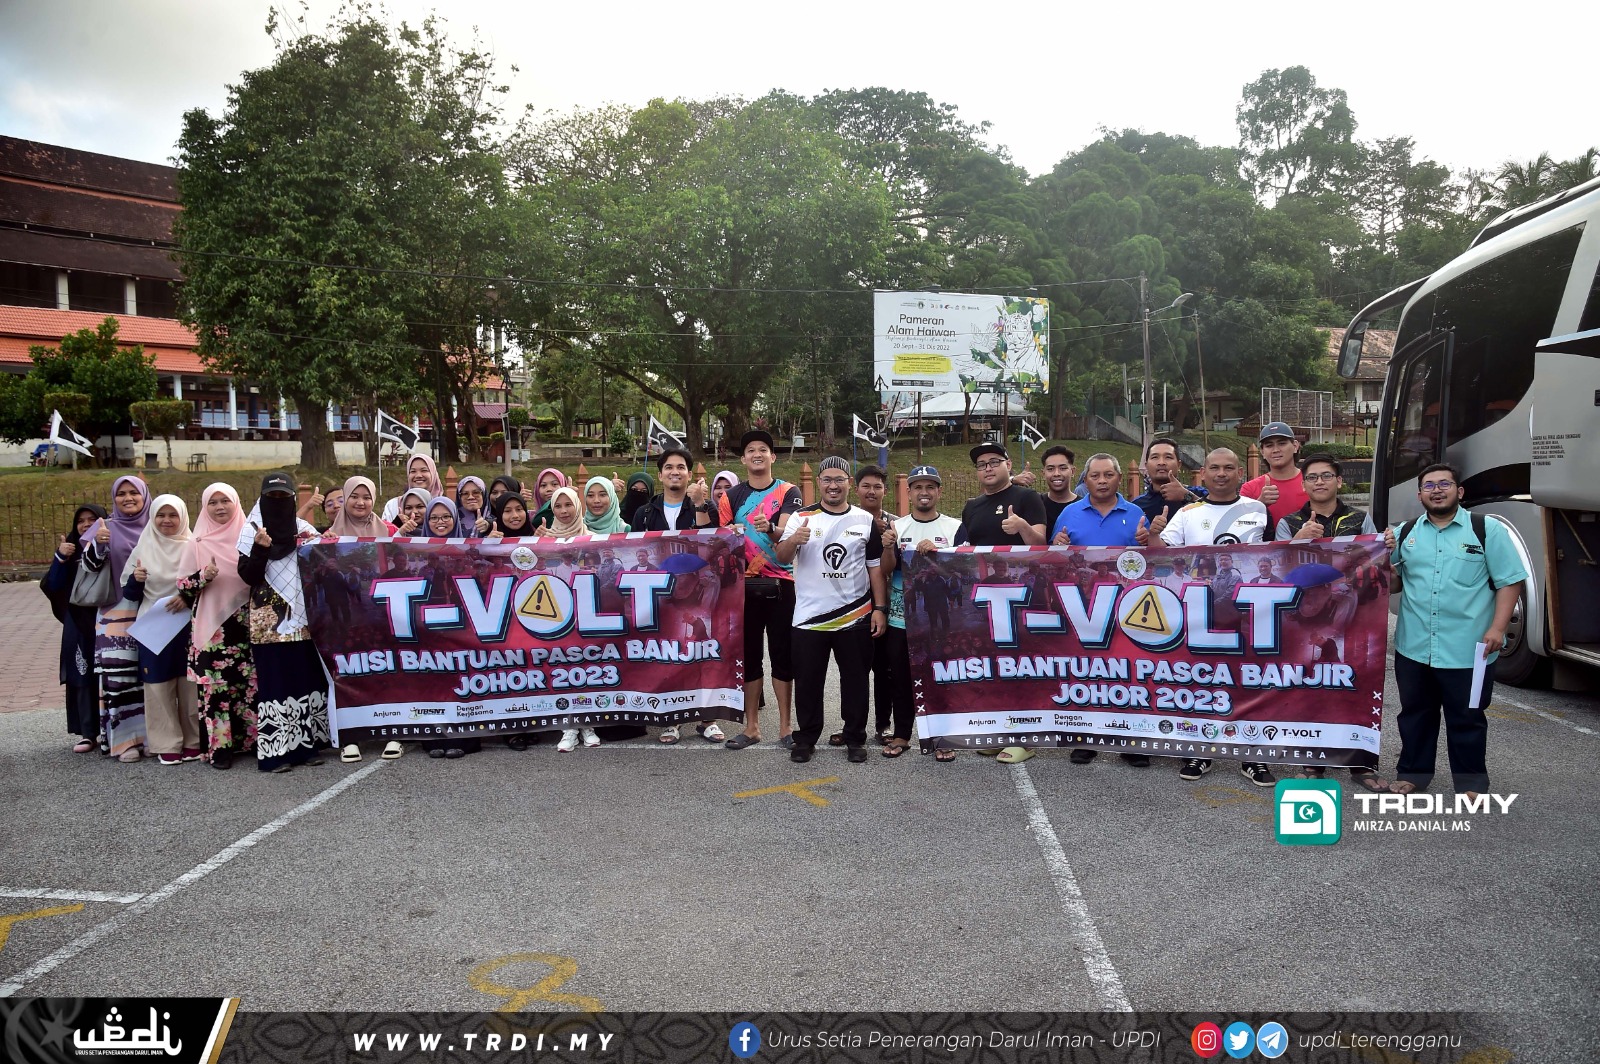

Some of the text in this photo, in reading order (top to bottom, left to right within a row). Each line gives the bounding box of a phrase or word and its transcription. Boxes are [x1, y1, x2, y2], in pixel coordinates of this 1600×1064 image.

[899, 313, 945, 326] Pameran
[887, 324, 956, 337] Alam Haiwan
[371, 571, 674, 642] T-VOLT
[974, 583, 1299, 652] T-VOLT
[334, 639, 721, 676] MISI BANTUAN PASCA BANJIR
[932, 656, 1356, 690] MISI BANTUAN PASCA BANJIR
[454, 665, 621, 697] JOHOR 2023
[663, 694, 696, 706] T-VOLT
[1052, 682, 1234, 716] JOHOR 2023
[373, 710, 401, 719] Anjuran
[456, 704, 484, 713] Dengan
[456, 708, 494, 718] Kerjasama
[371, 710, 701, 736] TERENGGANU MAJU BERKAT SEJAHTERA
[968, 718, 997, 727] Anjuran
[1054, 713, 1083, 721] Dengan
[1054, 719, 1093, 728] Kerjasama
[1281, 728, 1322, 738] T-VOLT
[965, 733, 1326, 760] TERENGGANU MAJU BERKAT SEJAHTERA
